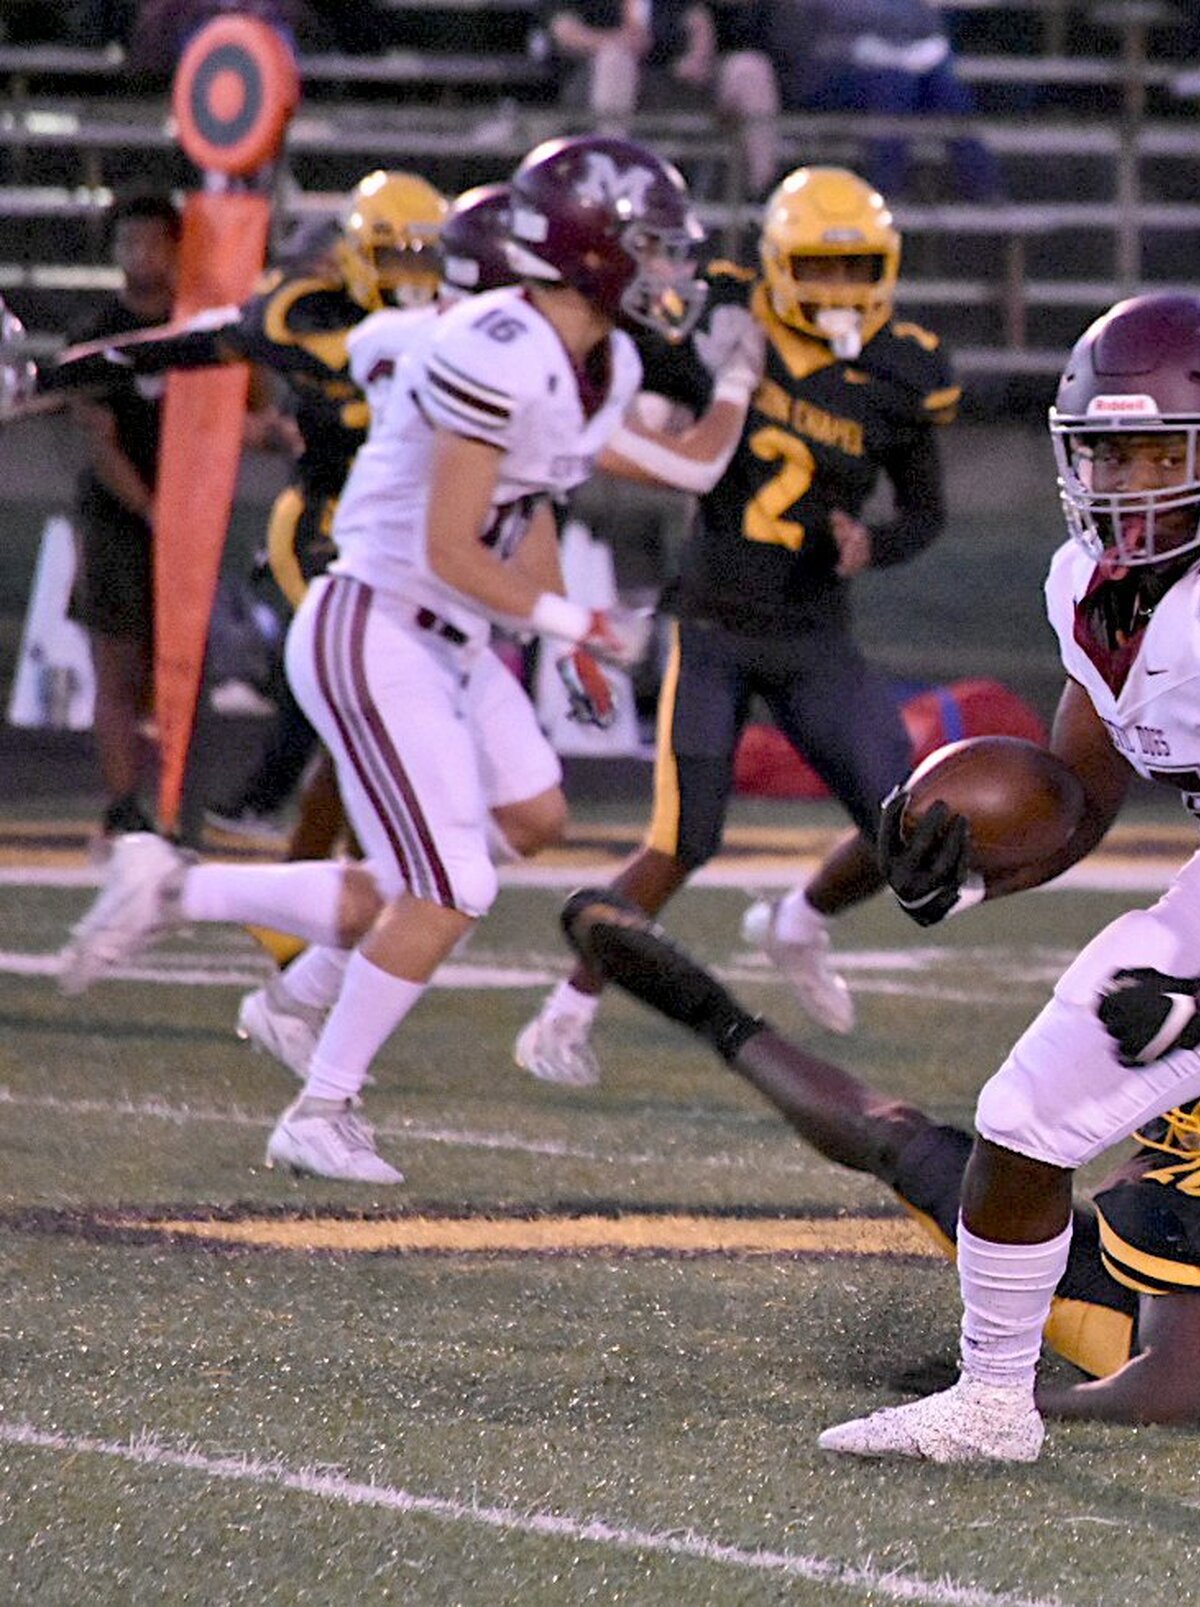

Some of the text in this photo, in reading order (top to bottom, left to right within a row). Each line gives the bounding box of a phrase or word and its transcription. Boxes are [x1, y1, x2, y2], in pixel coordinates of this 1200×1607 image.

[573, 151, 655, 217] M
[471, 308, 528, 345] 16
[744, 426, 817, 551] 2
